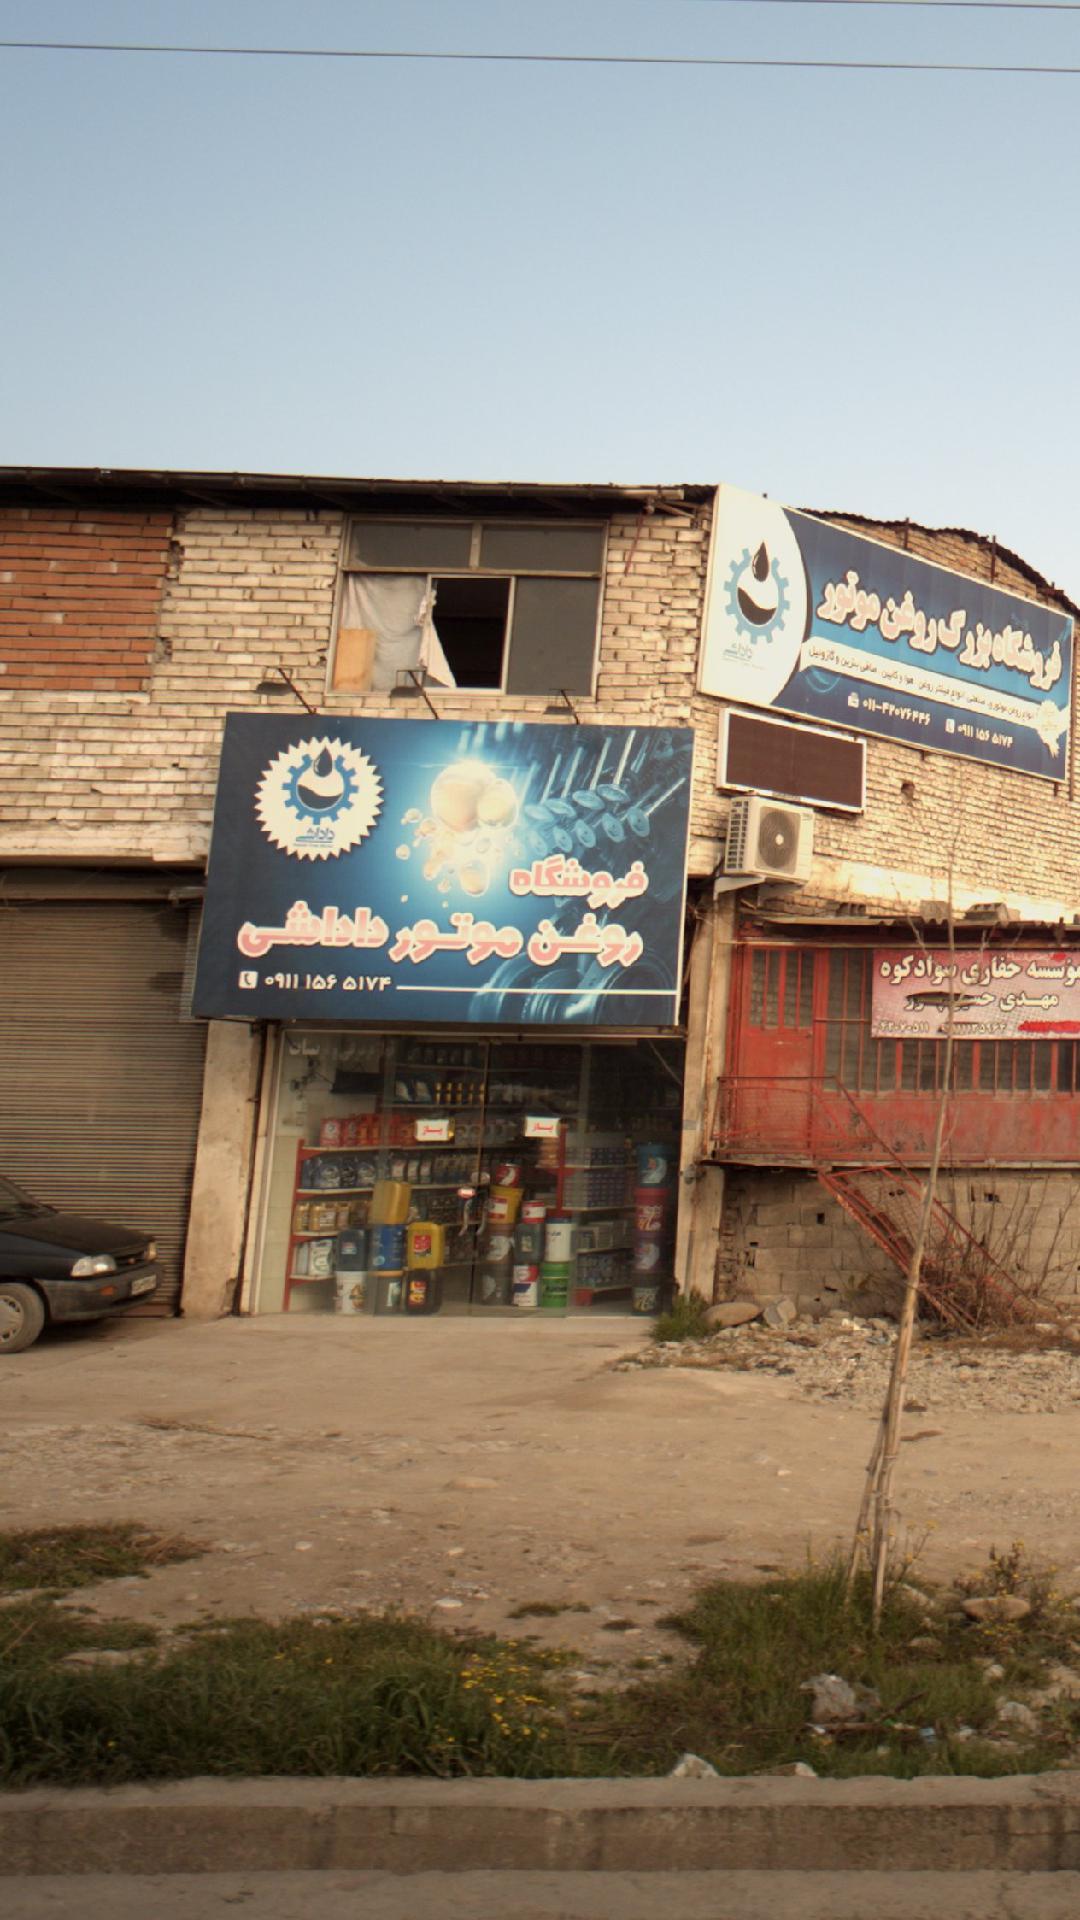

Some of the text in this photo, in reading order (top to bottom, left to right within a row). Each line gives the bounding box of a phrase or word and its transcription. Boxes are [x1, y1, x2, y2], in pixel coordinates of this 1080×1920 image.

[817, 570, 1063, 690] فروشگاه بزرگ روغن موتور
[510, 855, 648, 908] فروشگاه
[238, 901, 643, 966] روغن موتور داداشی
[265, 972, 392, 991] ۰۹۱۱ ۱۵۶ ۵۱۷۴
[880, 955, 956, 985] سوادکوه
[961, 955, 1021, 987] حفاری
[1000, 991, 1058, 1012] مهدی
